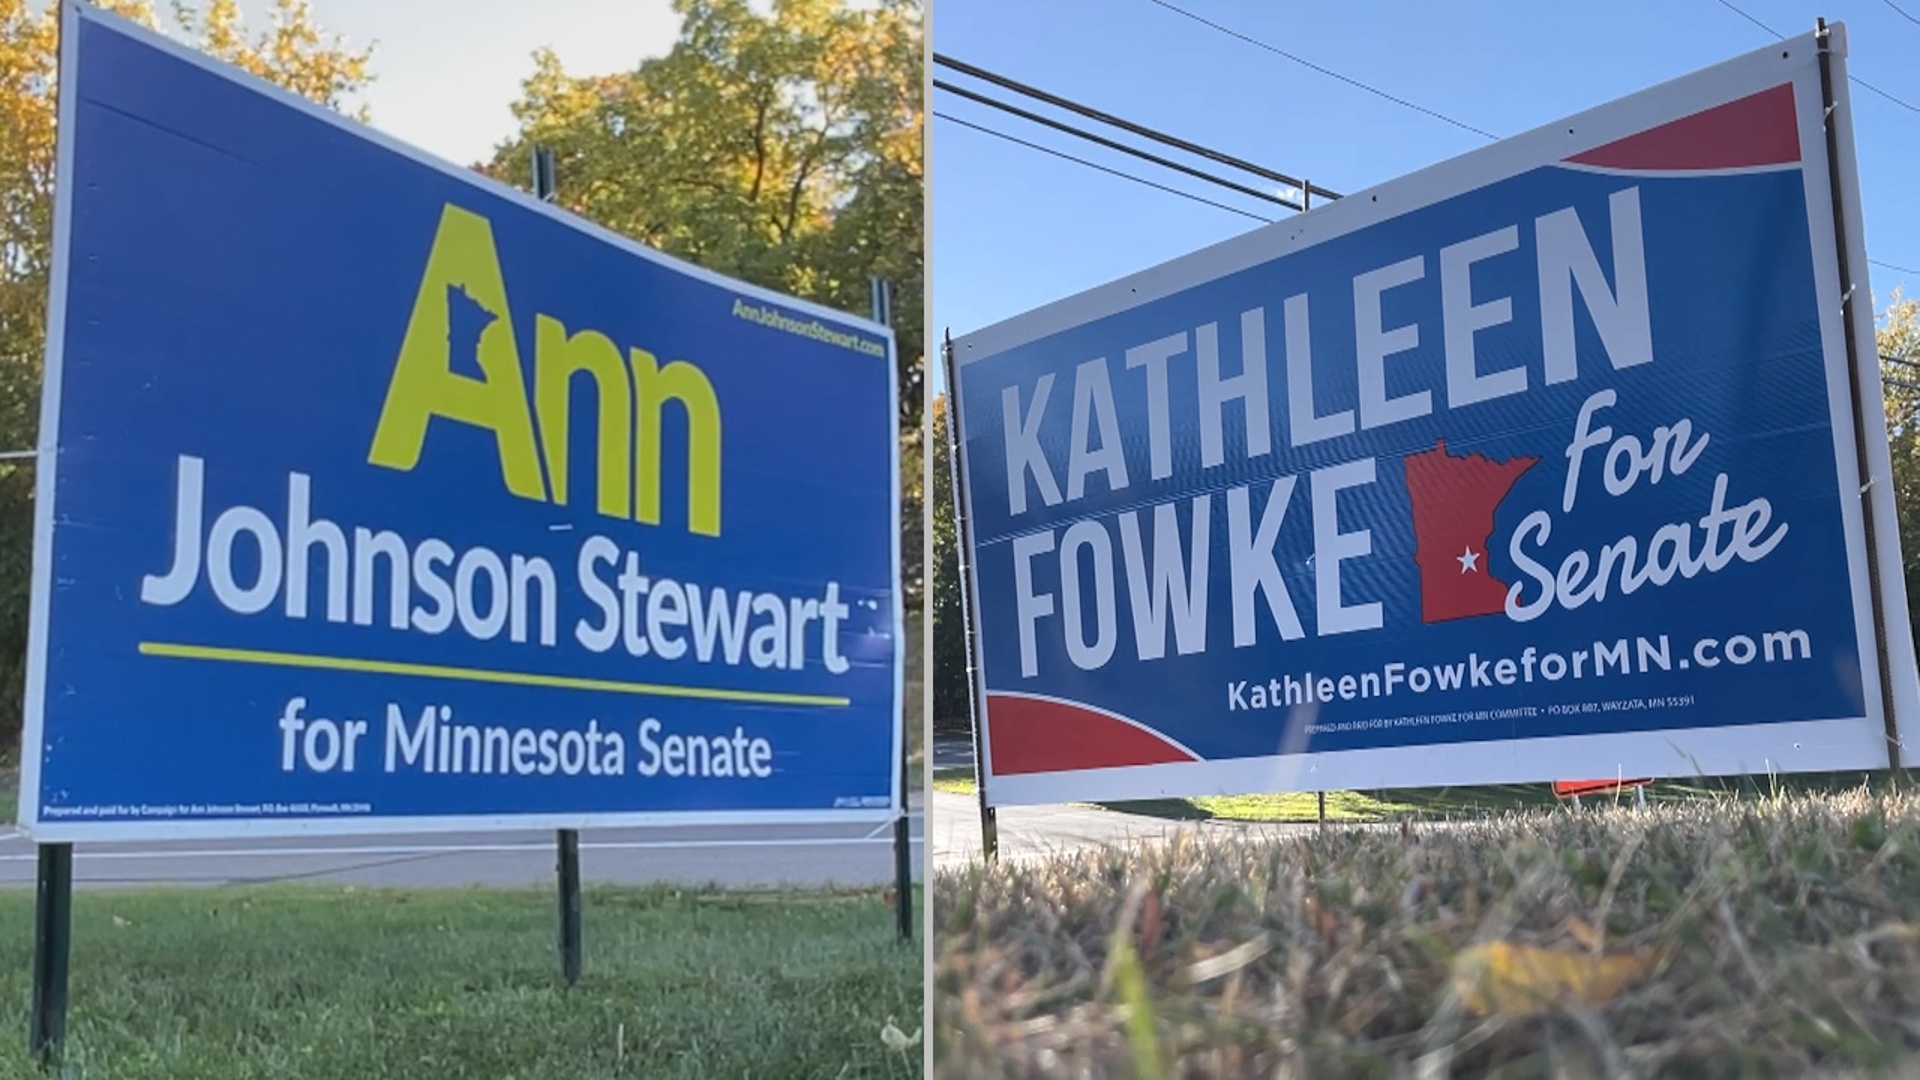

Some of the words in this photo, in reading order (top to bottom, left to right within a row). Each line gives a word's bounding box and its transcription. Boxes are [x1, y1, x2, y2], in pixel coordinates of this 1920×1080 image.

[367, 203, 721, 537] Ann
[732, 299, 885, 358] AnnJohnsonStewart.com
[1001, 186, 1654, 517] KATHLEEN
[1563, 389, 1709, 513] for
[141, 455, 557, 646] Johnson
[575, 535, 850, 673] Stewart
[1013, 458, 1383, 679] FOWKE
[1505, 473, 1789, 623] Senate
[1227, 627, 1812, 712] KathleenFowkeforMN.com
[1489, 706, 1538, 721] COMMITTEE
[1547, 704, 1561, 716] PO
[1562, 702, 1581, 715] BOX
[1602, 698, 1647, 712] WAYZATA,
[1649, 696, 1666, 709] MN
[1667, 694, 1695, 708] 55391
[279, 698, 367, 773] for
[384, 704, 625, 776] Minnesota
[637, 718, 773, 778] Senate
[43, 805, 82, 817] Prepared
[83, 804, 98, 815] and
[99, 804, 117, 817] paid
